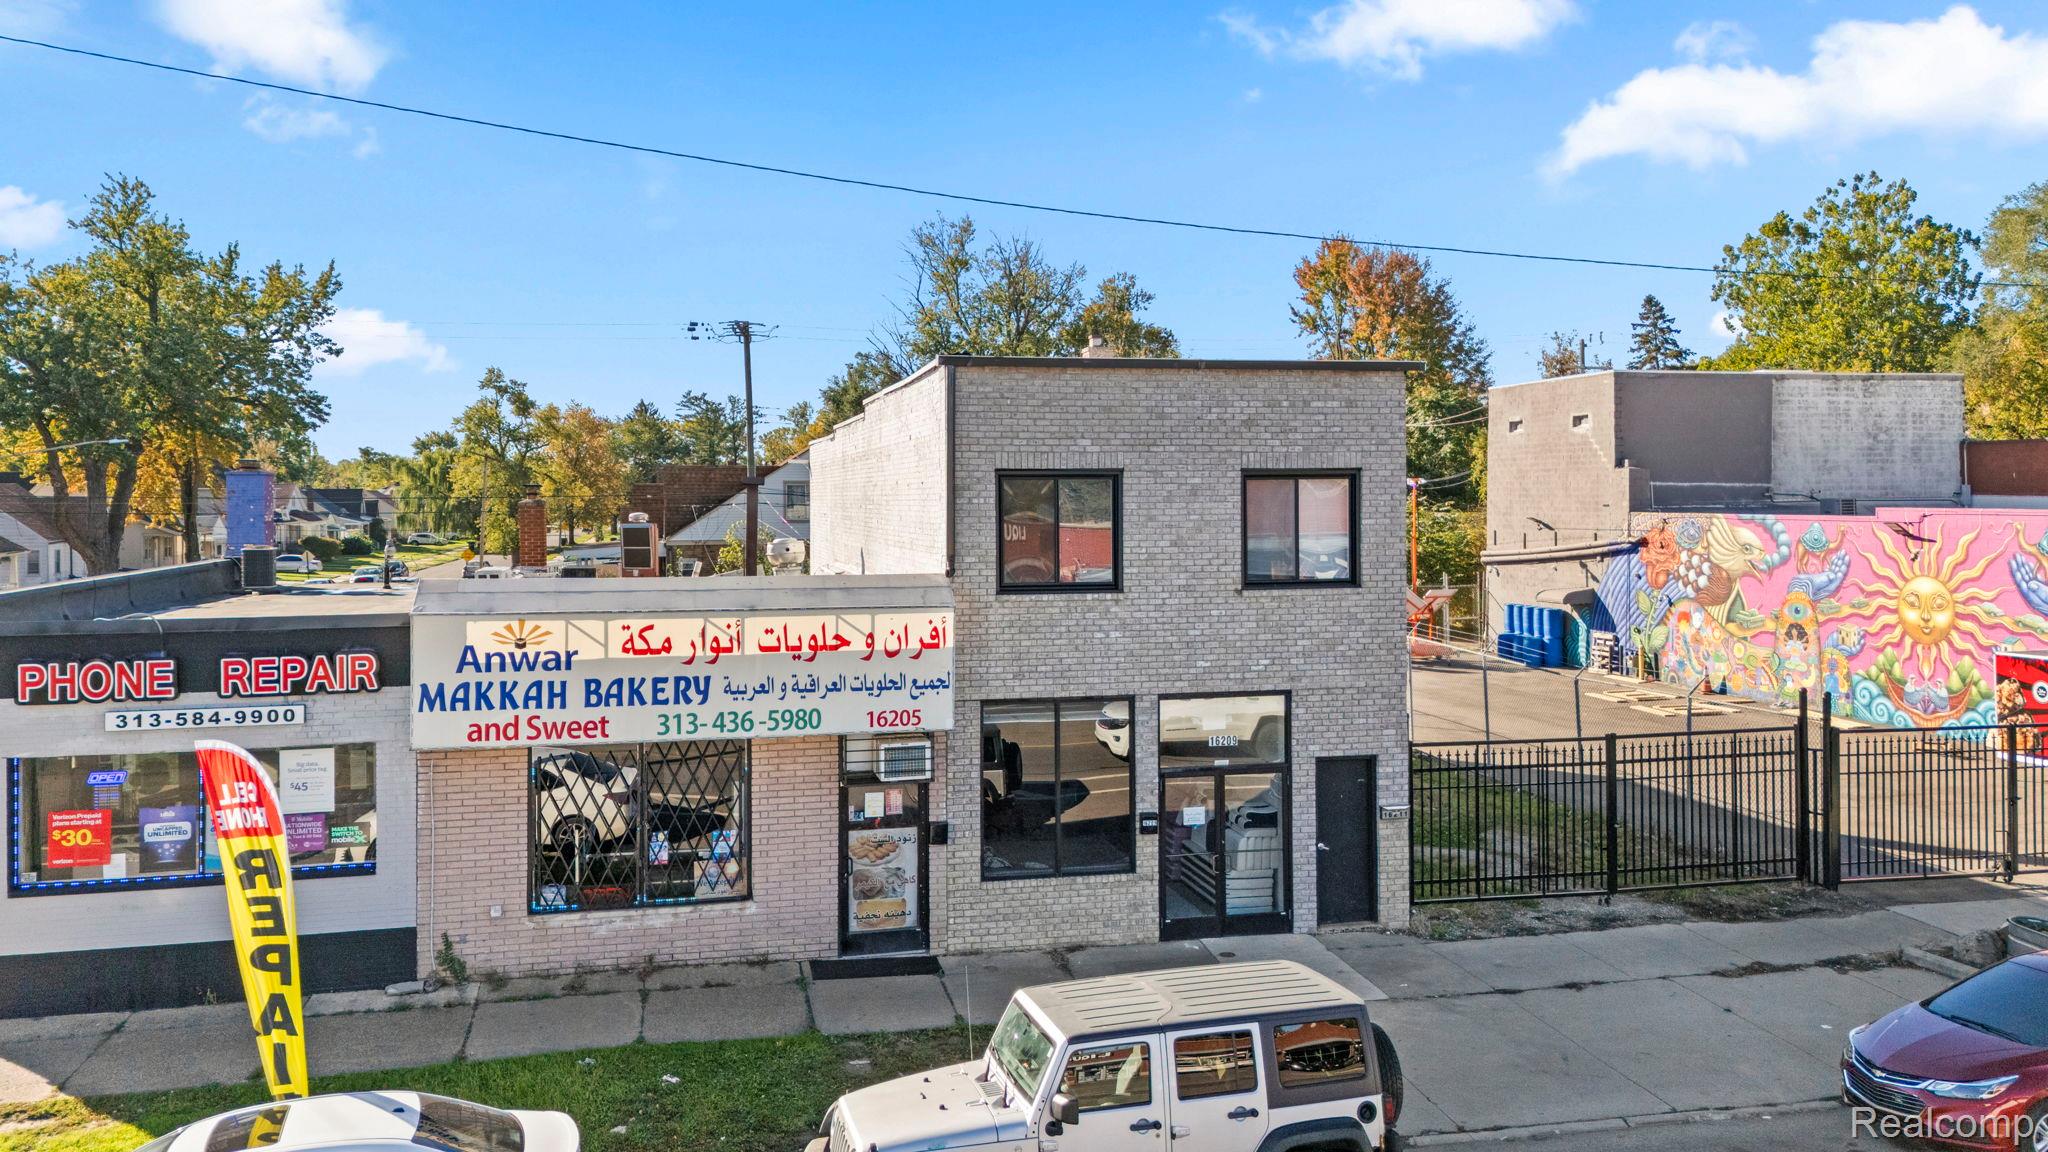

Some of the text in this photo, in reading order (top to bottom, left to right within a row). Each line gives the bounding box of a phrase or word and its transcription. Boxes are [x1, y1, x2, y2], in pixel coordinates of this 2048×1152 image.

[621, 616, 947, 665] أفران و حلويات أنوار مكة
[455, 645, 579, 673] Anwar
[17, 653, 379, 702] PHONE REPAIR
[723, 671, 951, 701] لجميع الحلويات العراقية و العربية
[418, 675, 711, 712] MAKKAH BAKERY
[115, 709, 296, 729] 313-584-9900
[467, 715, 610, 742] and Sweet
[866, 709, 922, 728] 16205
[1209, 736, 1237, 746] 16209
[89, 771, 126, 783] OPEN
[290, 781, 308, 791] $45
[52, 829, 93, 847] $30
